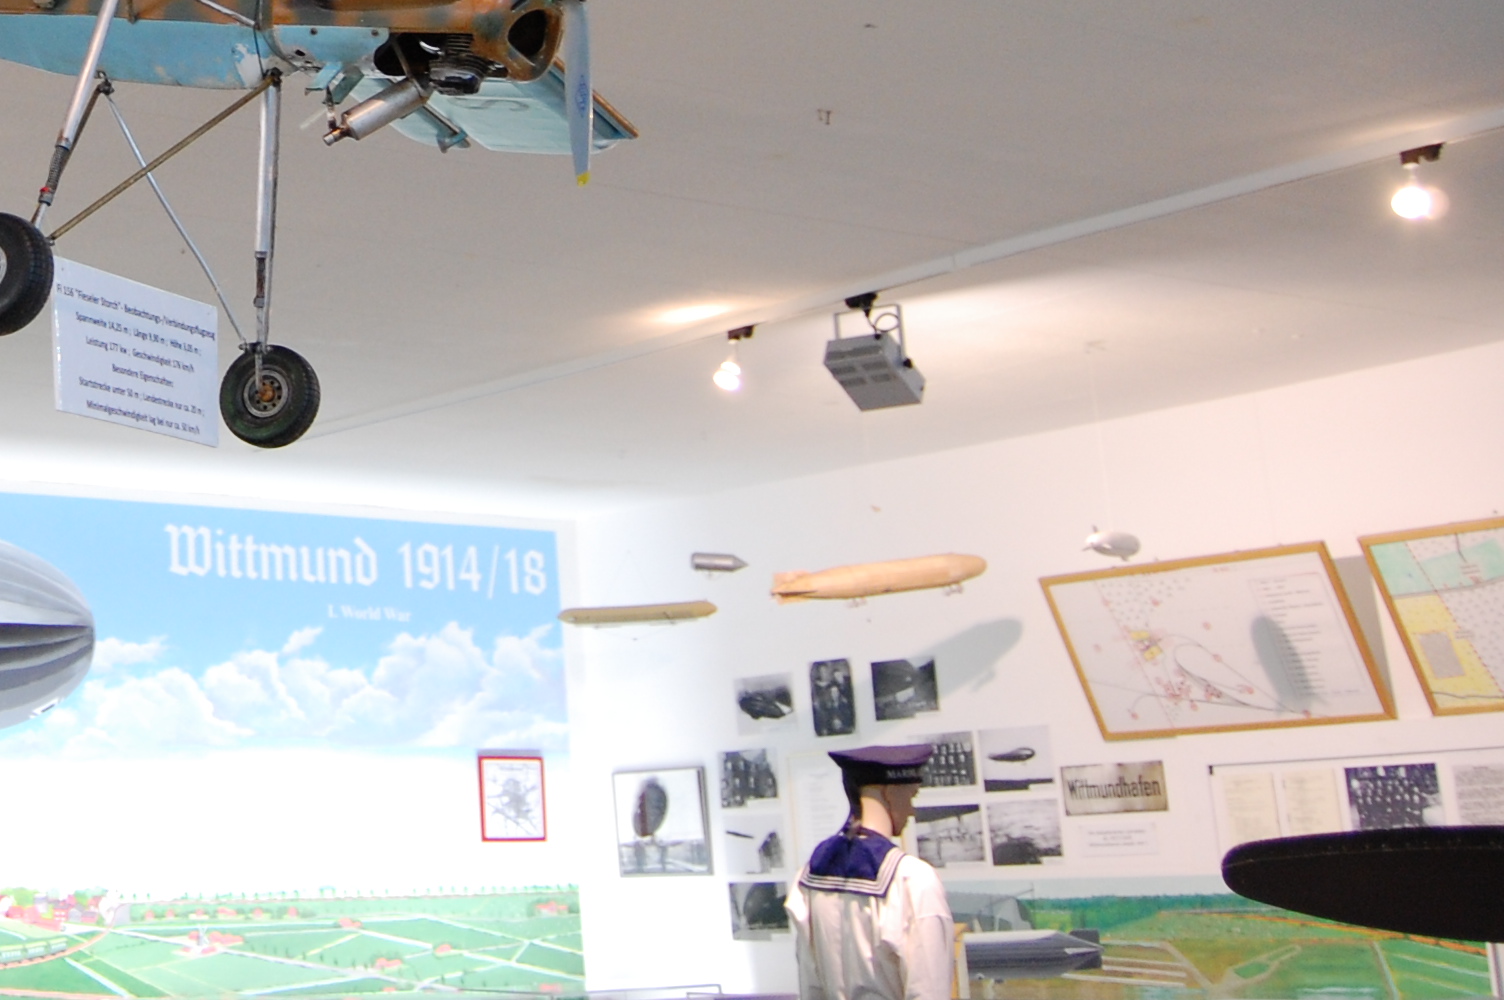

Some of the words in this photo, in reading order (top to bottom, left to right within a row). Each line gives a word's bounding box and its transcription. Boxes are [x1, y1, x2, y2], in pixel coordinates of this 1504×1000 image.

[165, 523, 378, 587] Wittmund
[399, 540, 547, 600] 1914/18
[340, 604, 381, 620] World
[383, 607, 412, 622] War
[1067, 774, 1161, 800] Wittmundhafen
